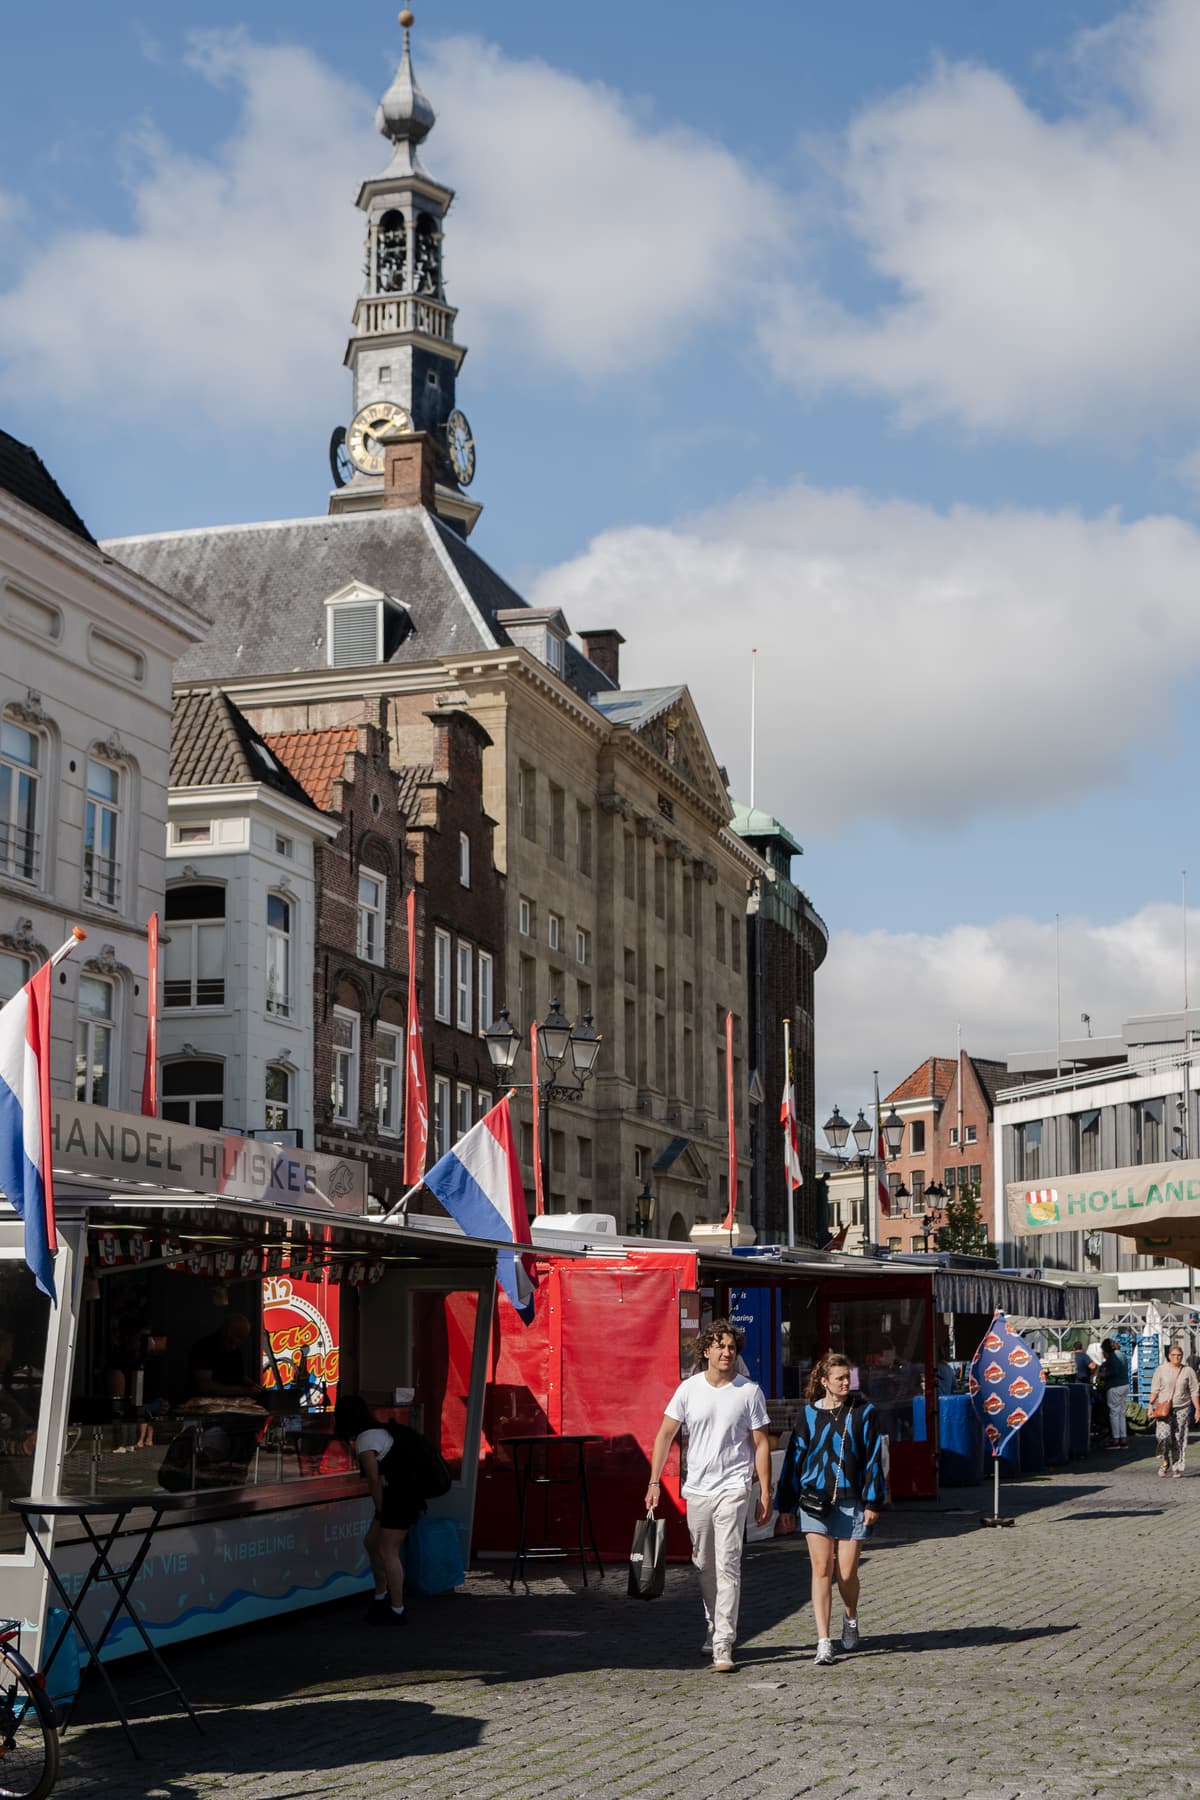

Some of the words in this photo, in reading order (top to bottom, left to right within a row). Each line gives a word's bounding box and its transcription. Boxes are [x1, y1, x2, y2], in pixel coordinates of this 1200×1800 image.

[200, 1143, 317, 1194] HUISKES
[223, 1534, 296, 1563] KIBBELING
[161, 1552, 188, 1576] VIS
